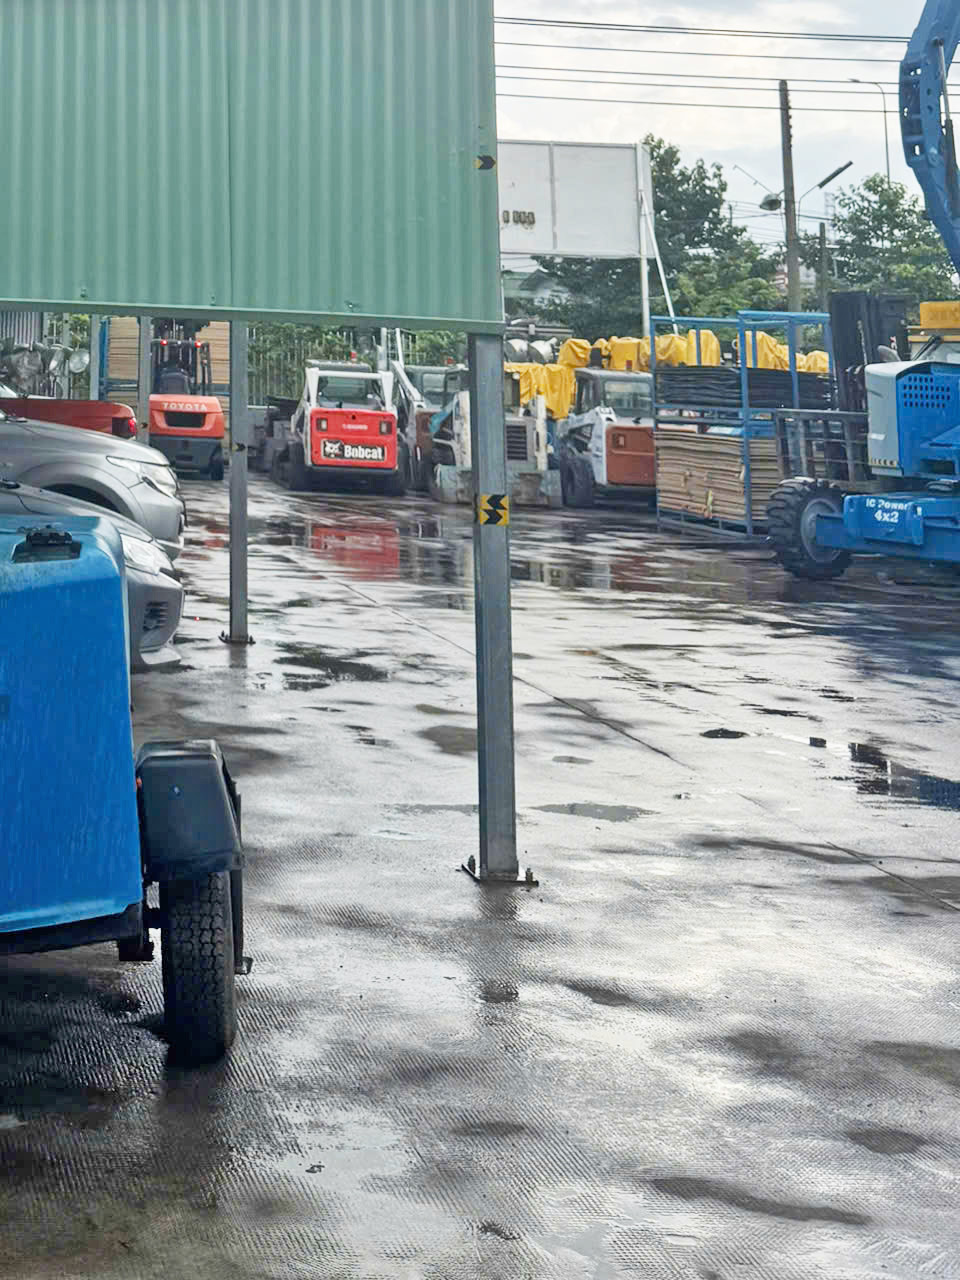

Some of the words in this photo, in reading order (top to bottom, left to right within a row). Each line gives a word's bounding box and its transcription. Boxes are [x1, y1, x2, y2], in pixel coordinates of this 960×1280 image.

[162, 402, 208, 412] TOYOTA
[344, 445, 383, 459] Bobcat
[866, 498, 876, 508] IC
[874, 509, 899, 523] 4x2
